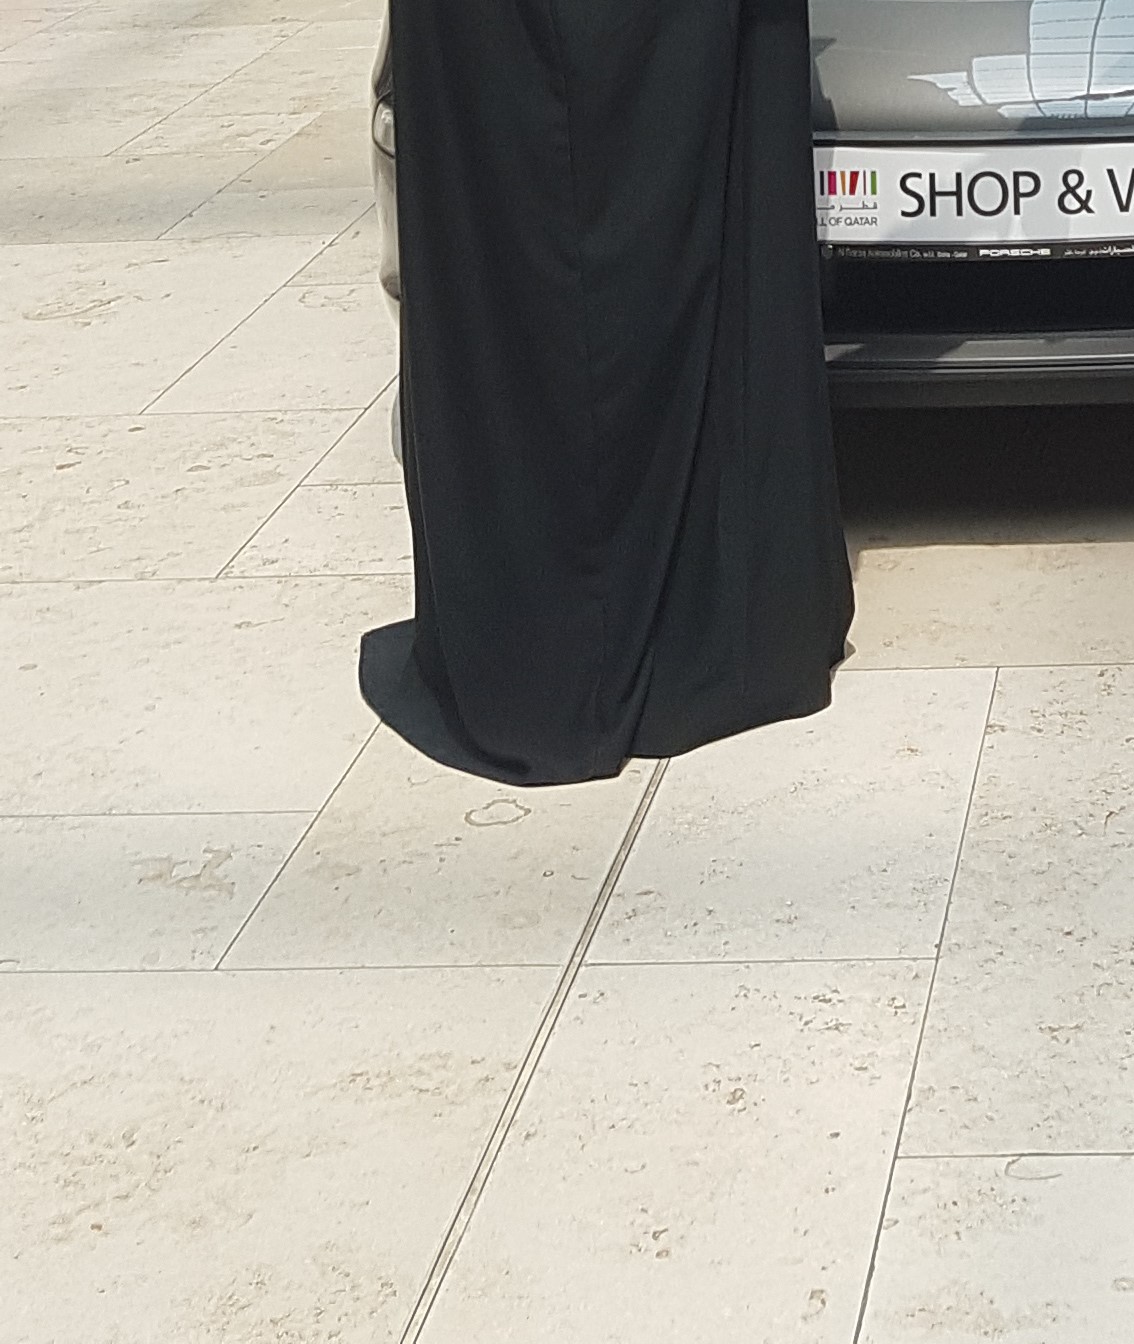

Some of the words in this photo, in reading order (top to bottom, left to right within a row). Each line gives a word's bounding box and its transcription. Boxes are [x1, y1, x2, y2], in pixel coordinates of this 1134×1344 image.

[899, 170, 1042, 218] SHOP
[1057, 168, 1095, 216] &
[829, 217, 842, 227] OF
[844, 217, 878, 227] QATAR
[979, 248, 1051, 257] PORSCHE
